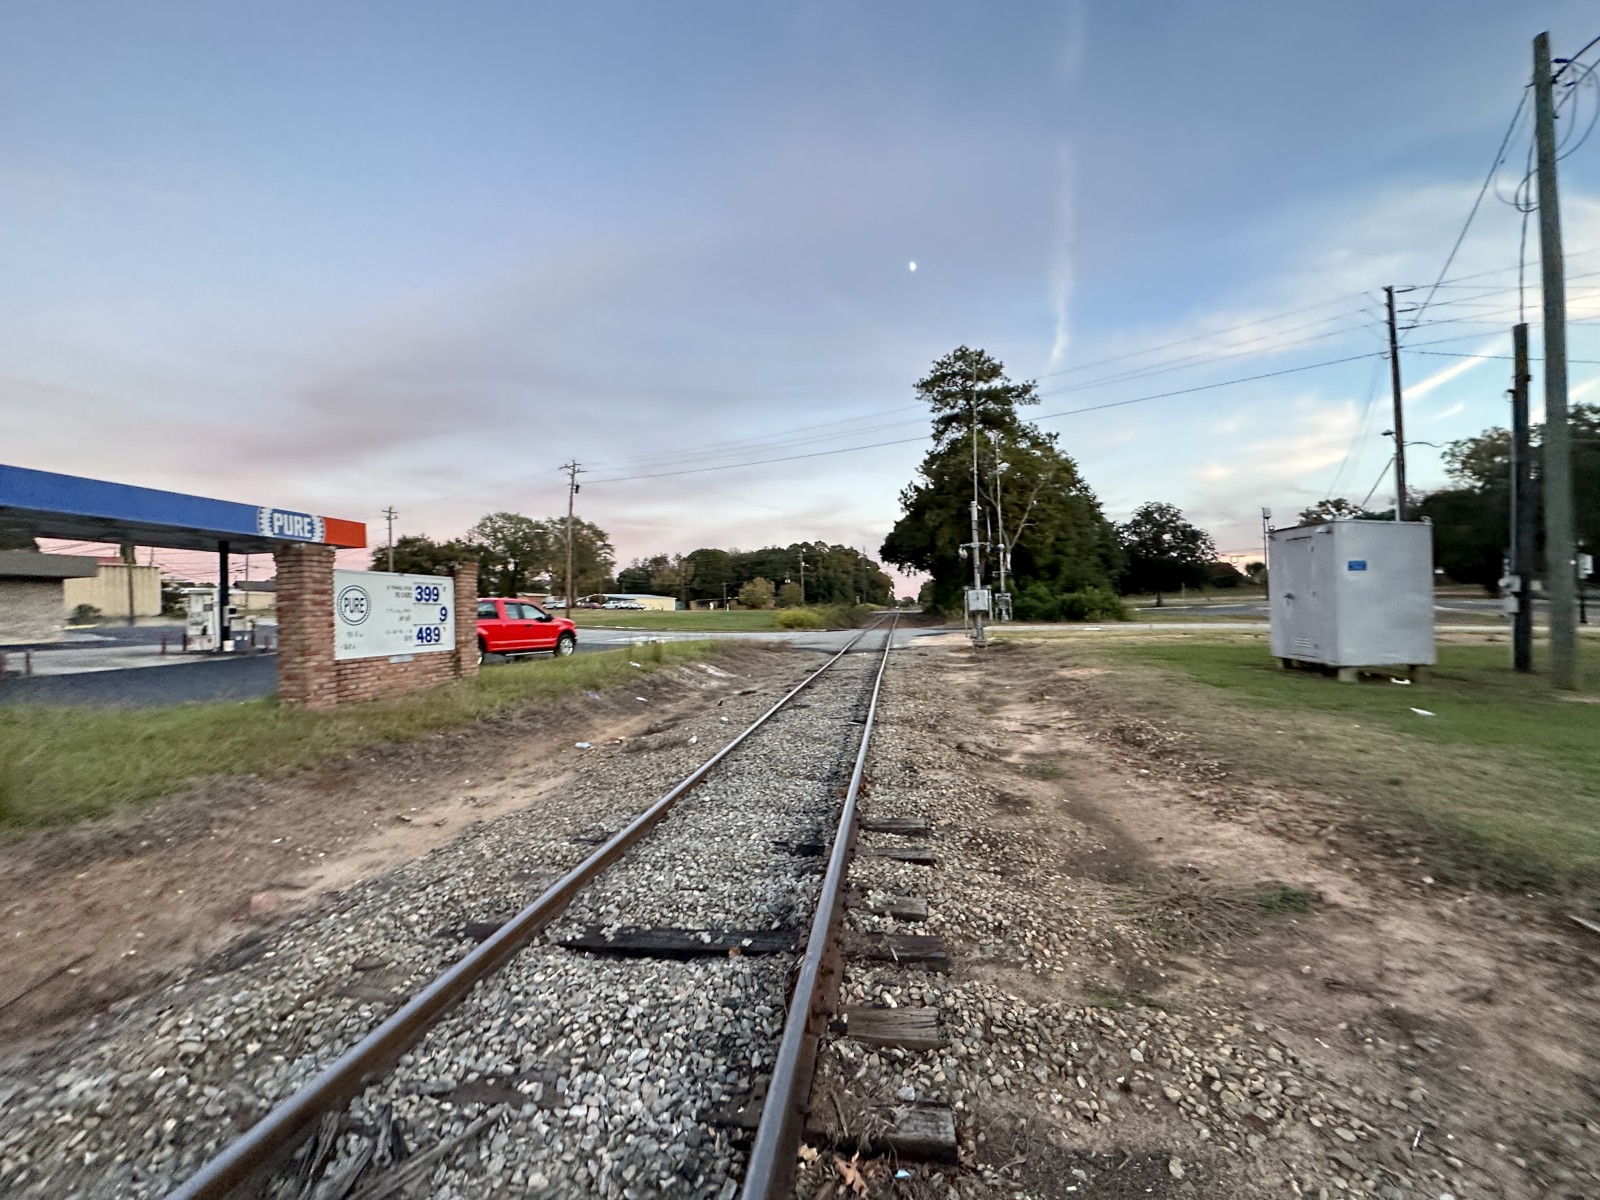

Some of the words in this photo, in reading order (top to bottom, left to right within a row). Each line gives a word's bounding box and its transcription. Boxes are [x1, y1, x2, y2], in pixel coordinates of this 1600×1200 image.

[272, 512, 312, 538] PURE
[415, 585, 440, 603] 399
[343, 597, 365, 614] PURE
[439, 606, 448, 622] 9
[416, 626, 441, 643] 489
